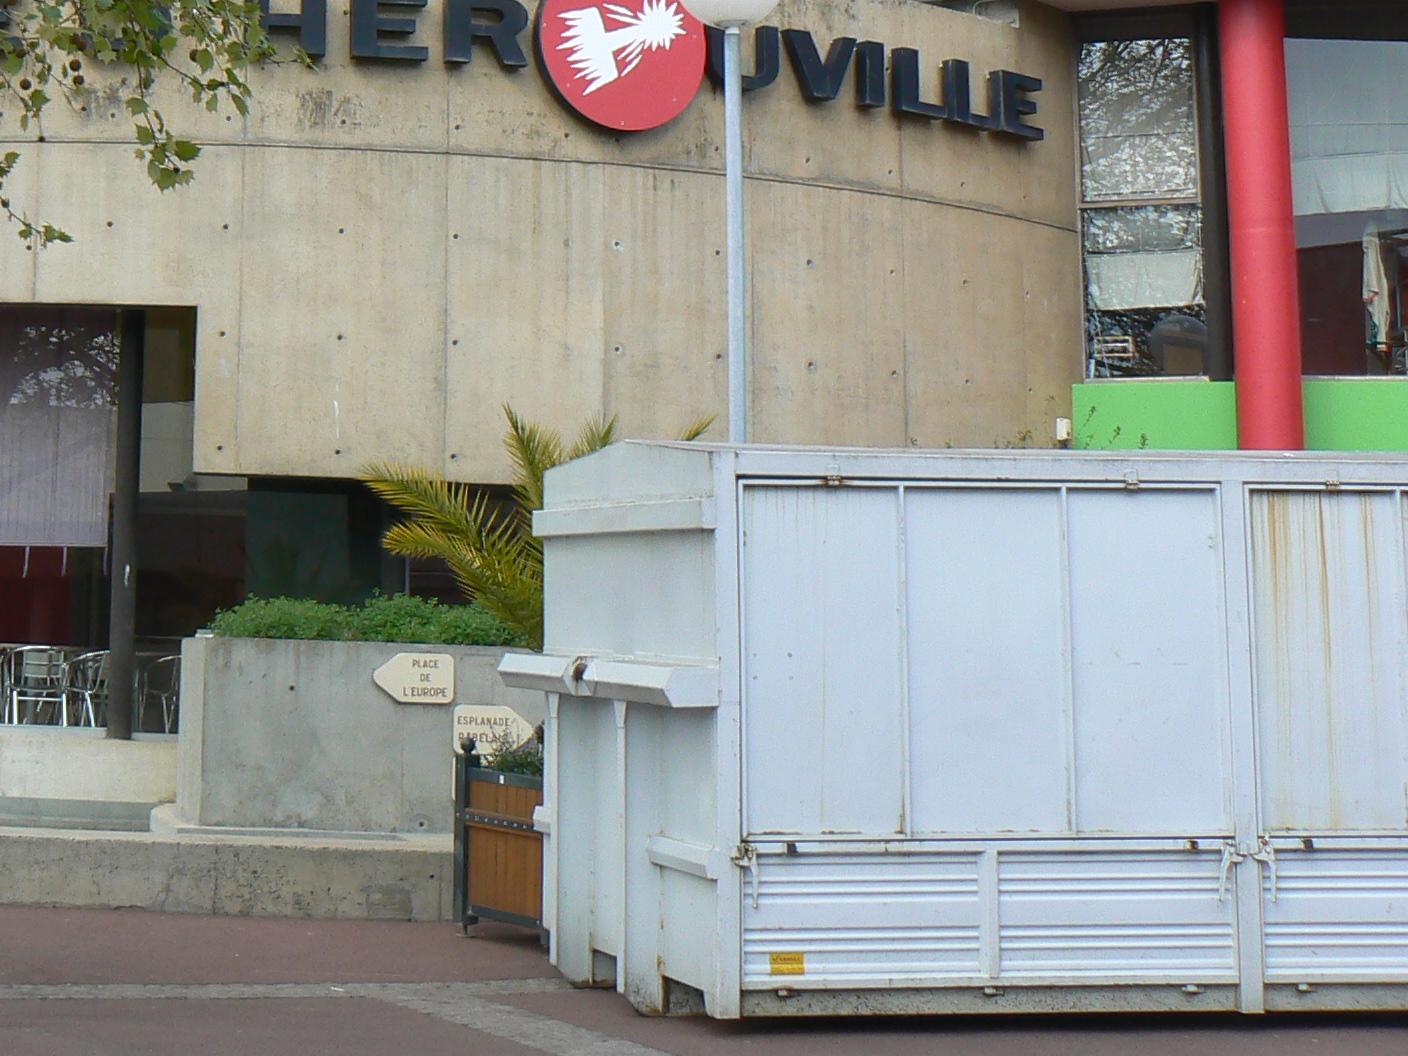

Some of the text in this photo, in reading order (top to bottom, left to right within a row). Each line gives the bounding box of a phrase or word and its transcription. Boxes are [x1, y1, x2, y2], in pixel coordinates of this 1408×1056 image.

[412, 659, 439, 668] PLACE
[420, 673, 431, 682] DE
[403, 687, 448, 697] L'EUROPE
[457, 716, 510, 726] ESPLANADE
